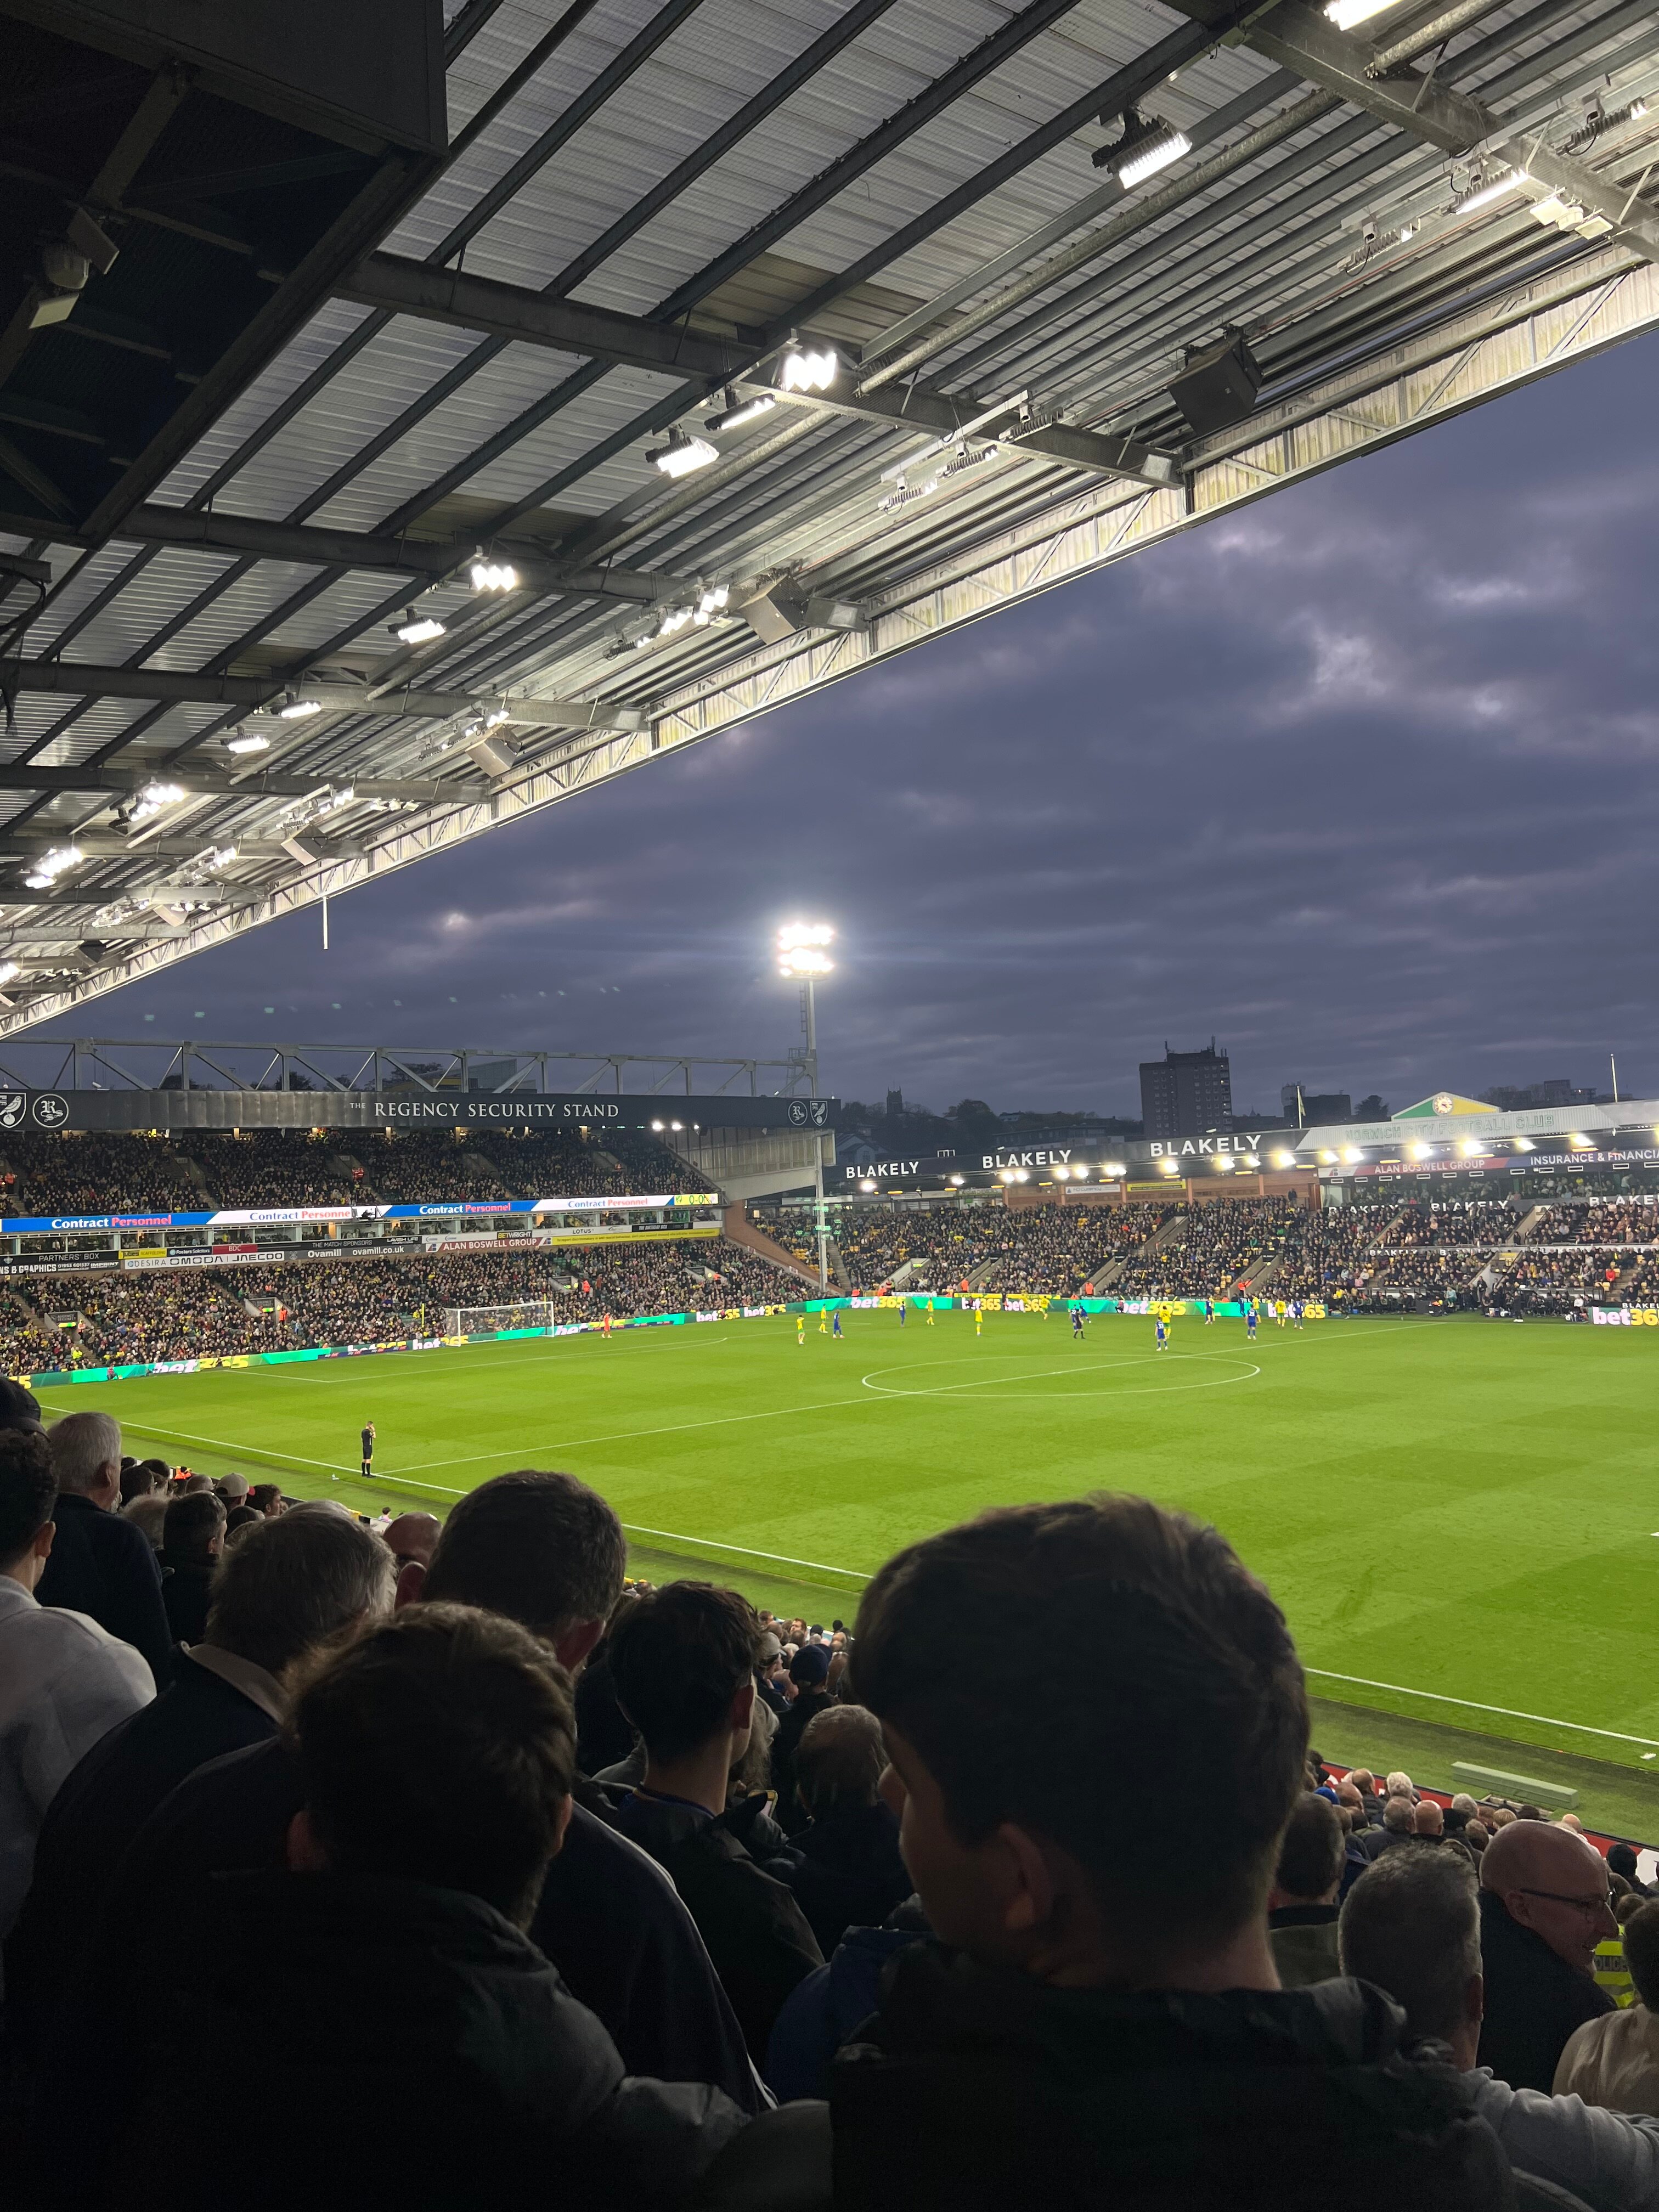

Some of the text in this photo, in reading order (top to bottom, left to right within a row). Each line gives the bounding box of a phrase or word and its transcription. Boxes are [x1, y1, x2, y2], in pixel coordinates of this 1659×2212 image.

[374, 1102, 461, 1116] REGENCY
[468, 1103, 556, 1117] SECURITY
[563, 1104, 619, 1117] STAND
[1346, 1115, 1554, 1141] NORWICH CITY FOOTBALL CLUB
[1150, 1134, 1261, 1158] BLAKELY
[981, 1149, 1072, 1170] BLAKELY
[1531, 1153, 1594, 1165] INSURANCE
[1597, 1153, 1605, 1162] &
[846, 1161, 919, 1179] BLAKELY
[1375, 1160, 1485, 1174] ALAN BOSWELL GROUP
[420, 1202, 511, 1215] Contract Personnel
[607, 1198, 648, 1206] Personnel
[52, 1215, 172, 1229] Contract Personnel
[250, 1210, 351, 1221] Contract Personne
[443, 1238, 537, 1250] ALAN BOSWELL GROUP
[38, 1254, 82, 1262] PARTNERS'
[308, 1245, 404, 1258] Ovamill ovamill.co.uk
[134, 1259, 166, 1267] DESIRA
[170, 1252, 283, 1265] OMODA JAECOO
[19, 1264, 57, 1274] GRAPHICS
[851, 1296, 906, 1308] bet365
[1268, 1302, 1325, 1319] bt65
[1592, 1306, 1659, 1326] bet36
[1595, 1956, 1628, 1971] OLICE
